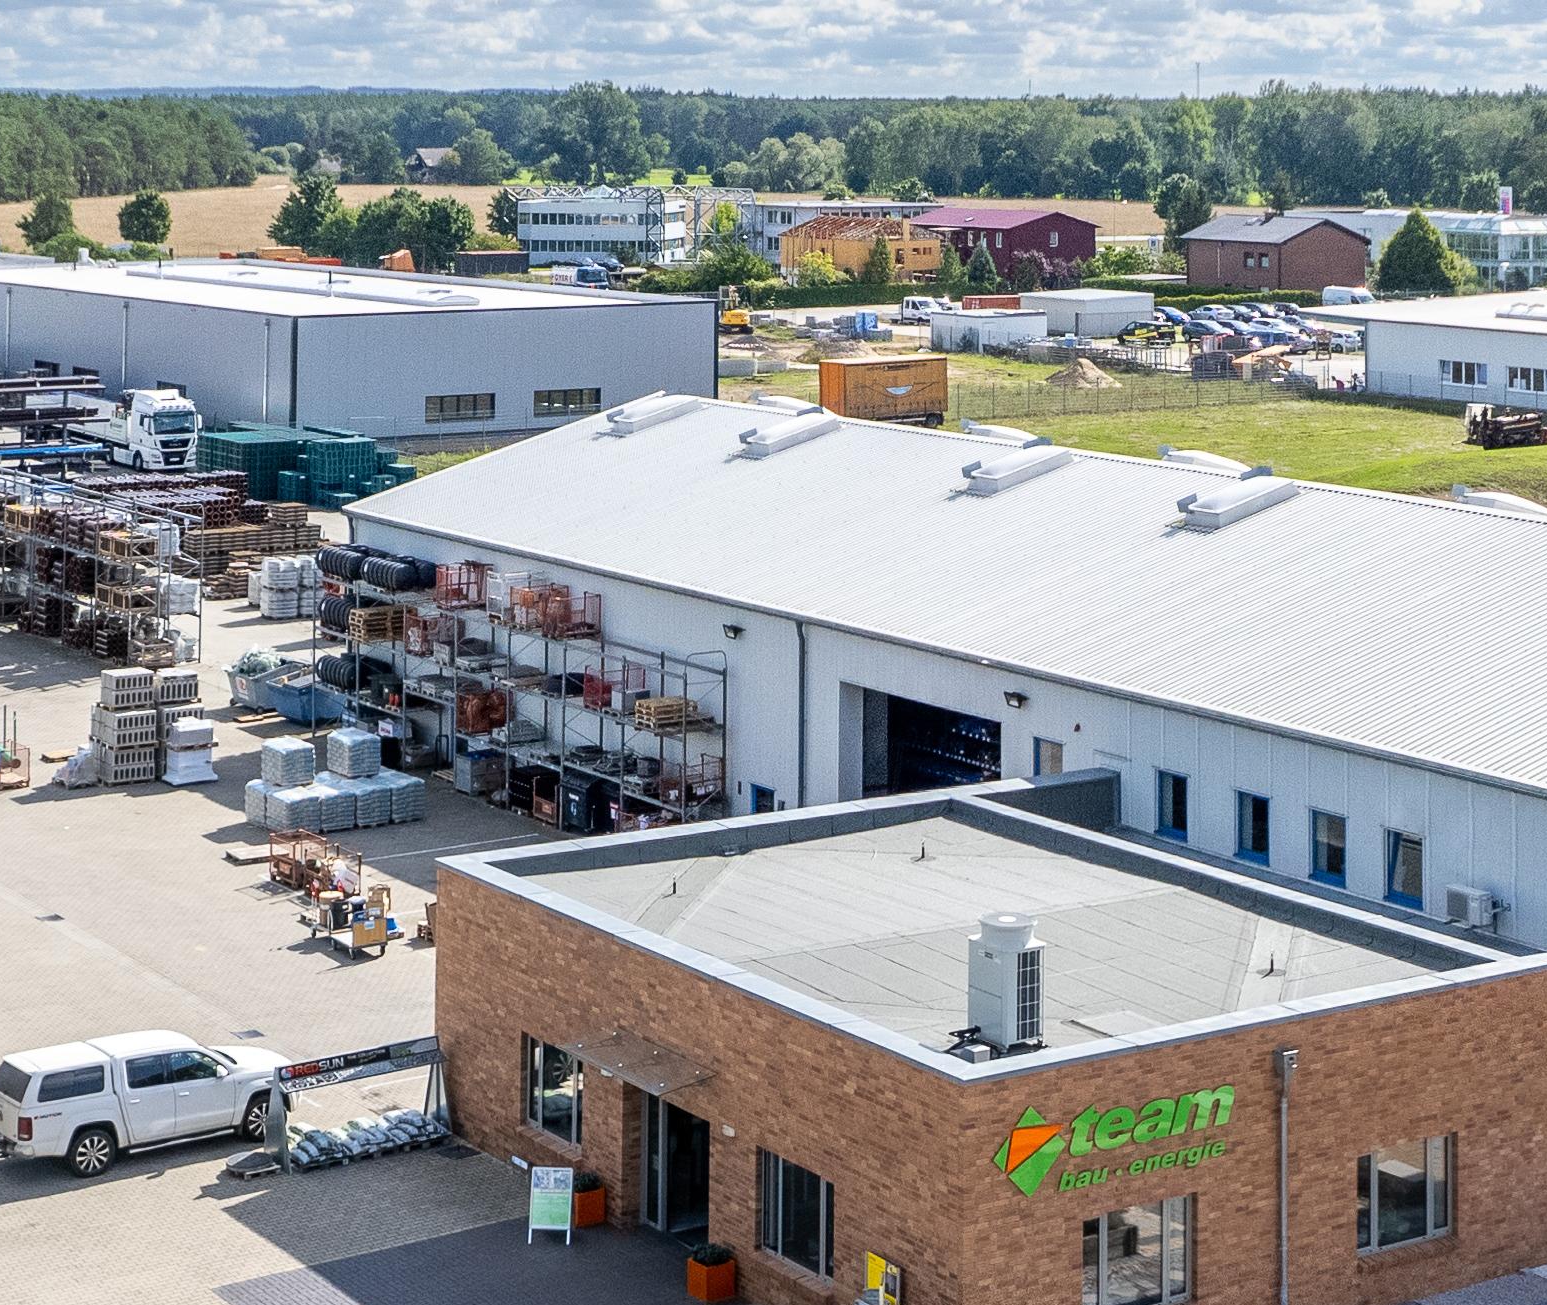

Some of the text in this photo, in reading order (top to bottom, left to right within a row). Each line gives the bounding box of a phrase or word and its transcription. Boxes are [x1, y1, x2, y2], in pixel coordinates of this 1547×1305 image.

[1069, 1083, 1236, 1158] team
[1058, 1139, 1227, 1193] bau energie
